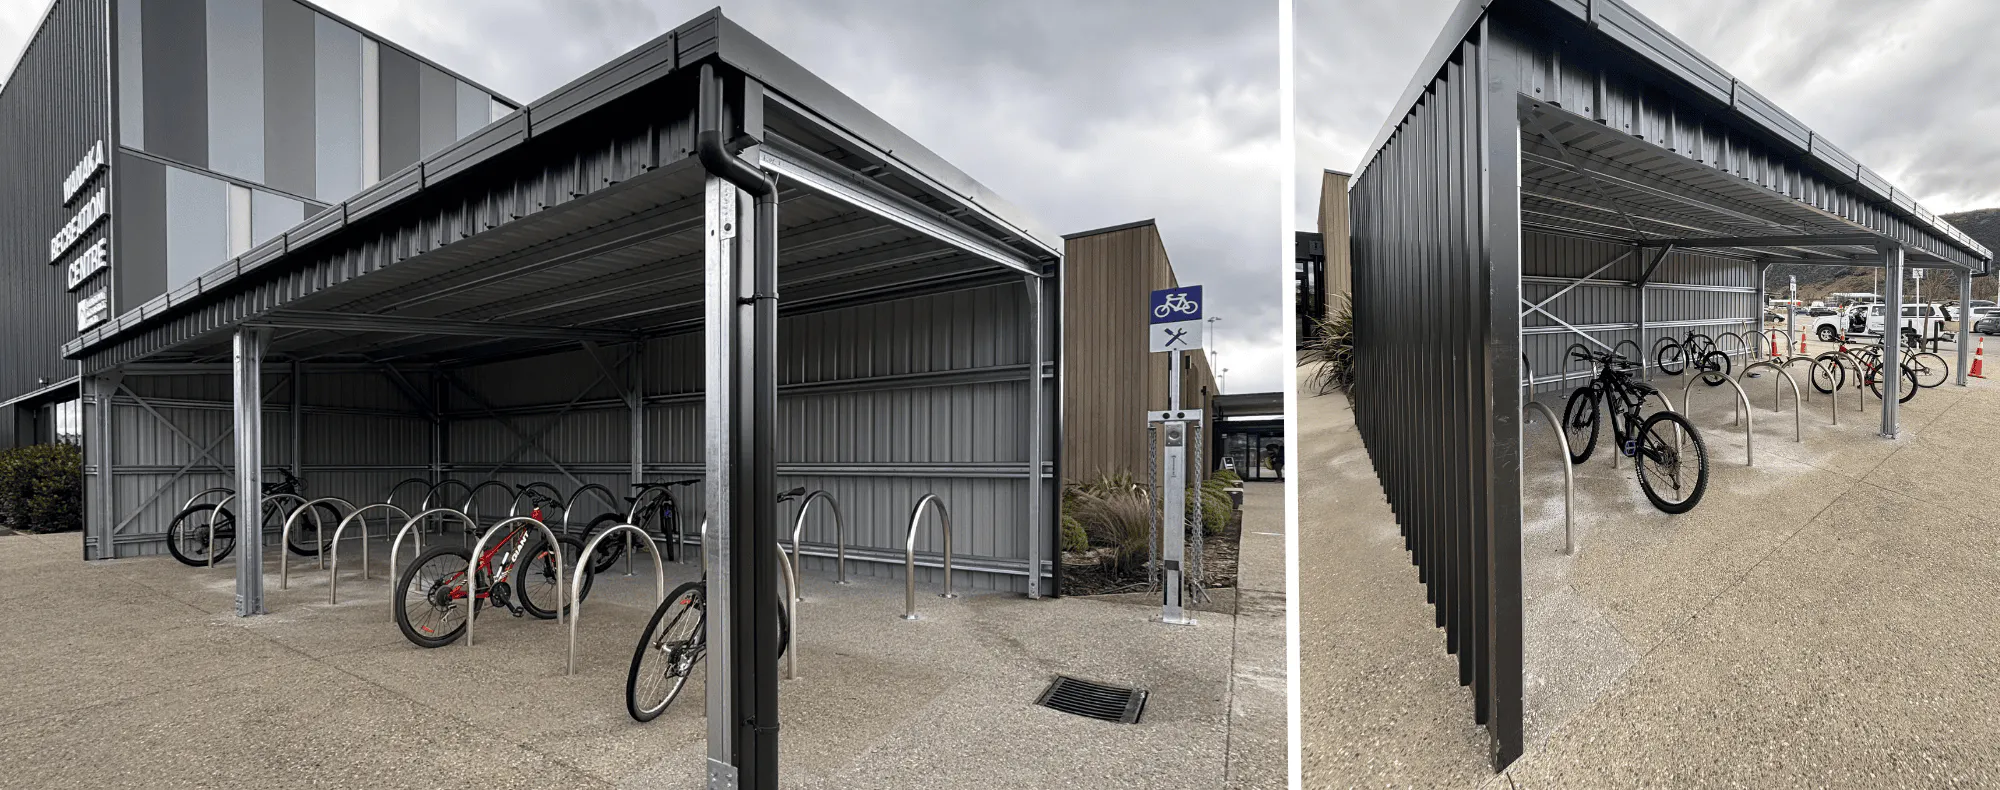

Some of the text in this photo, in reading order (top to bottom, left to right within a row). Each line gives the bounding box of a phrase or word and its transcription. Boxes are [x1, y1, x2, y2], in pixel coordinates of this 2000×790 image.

[63, 140, 104, 204] WANAKA
[51, 187, 106, 262] RECREATION
[68, 237, 107, 290] CENTRE
[511, 530, 529, 563] GIANT
